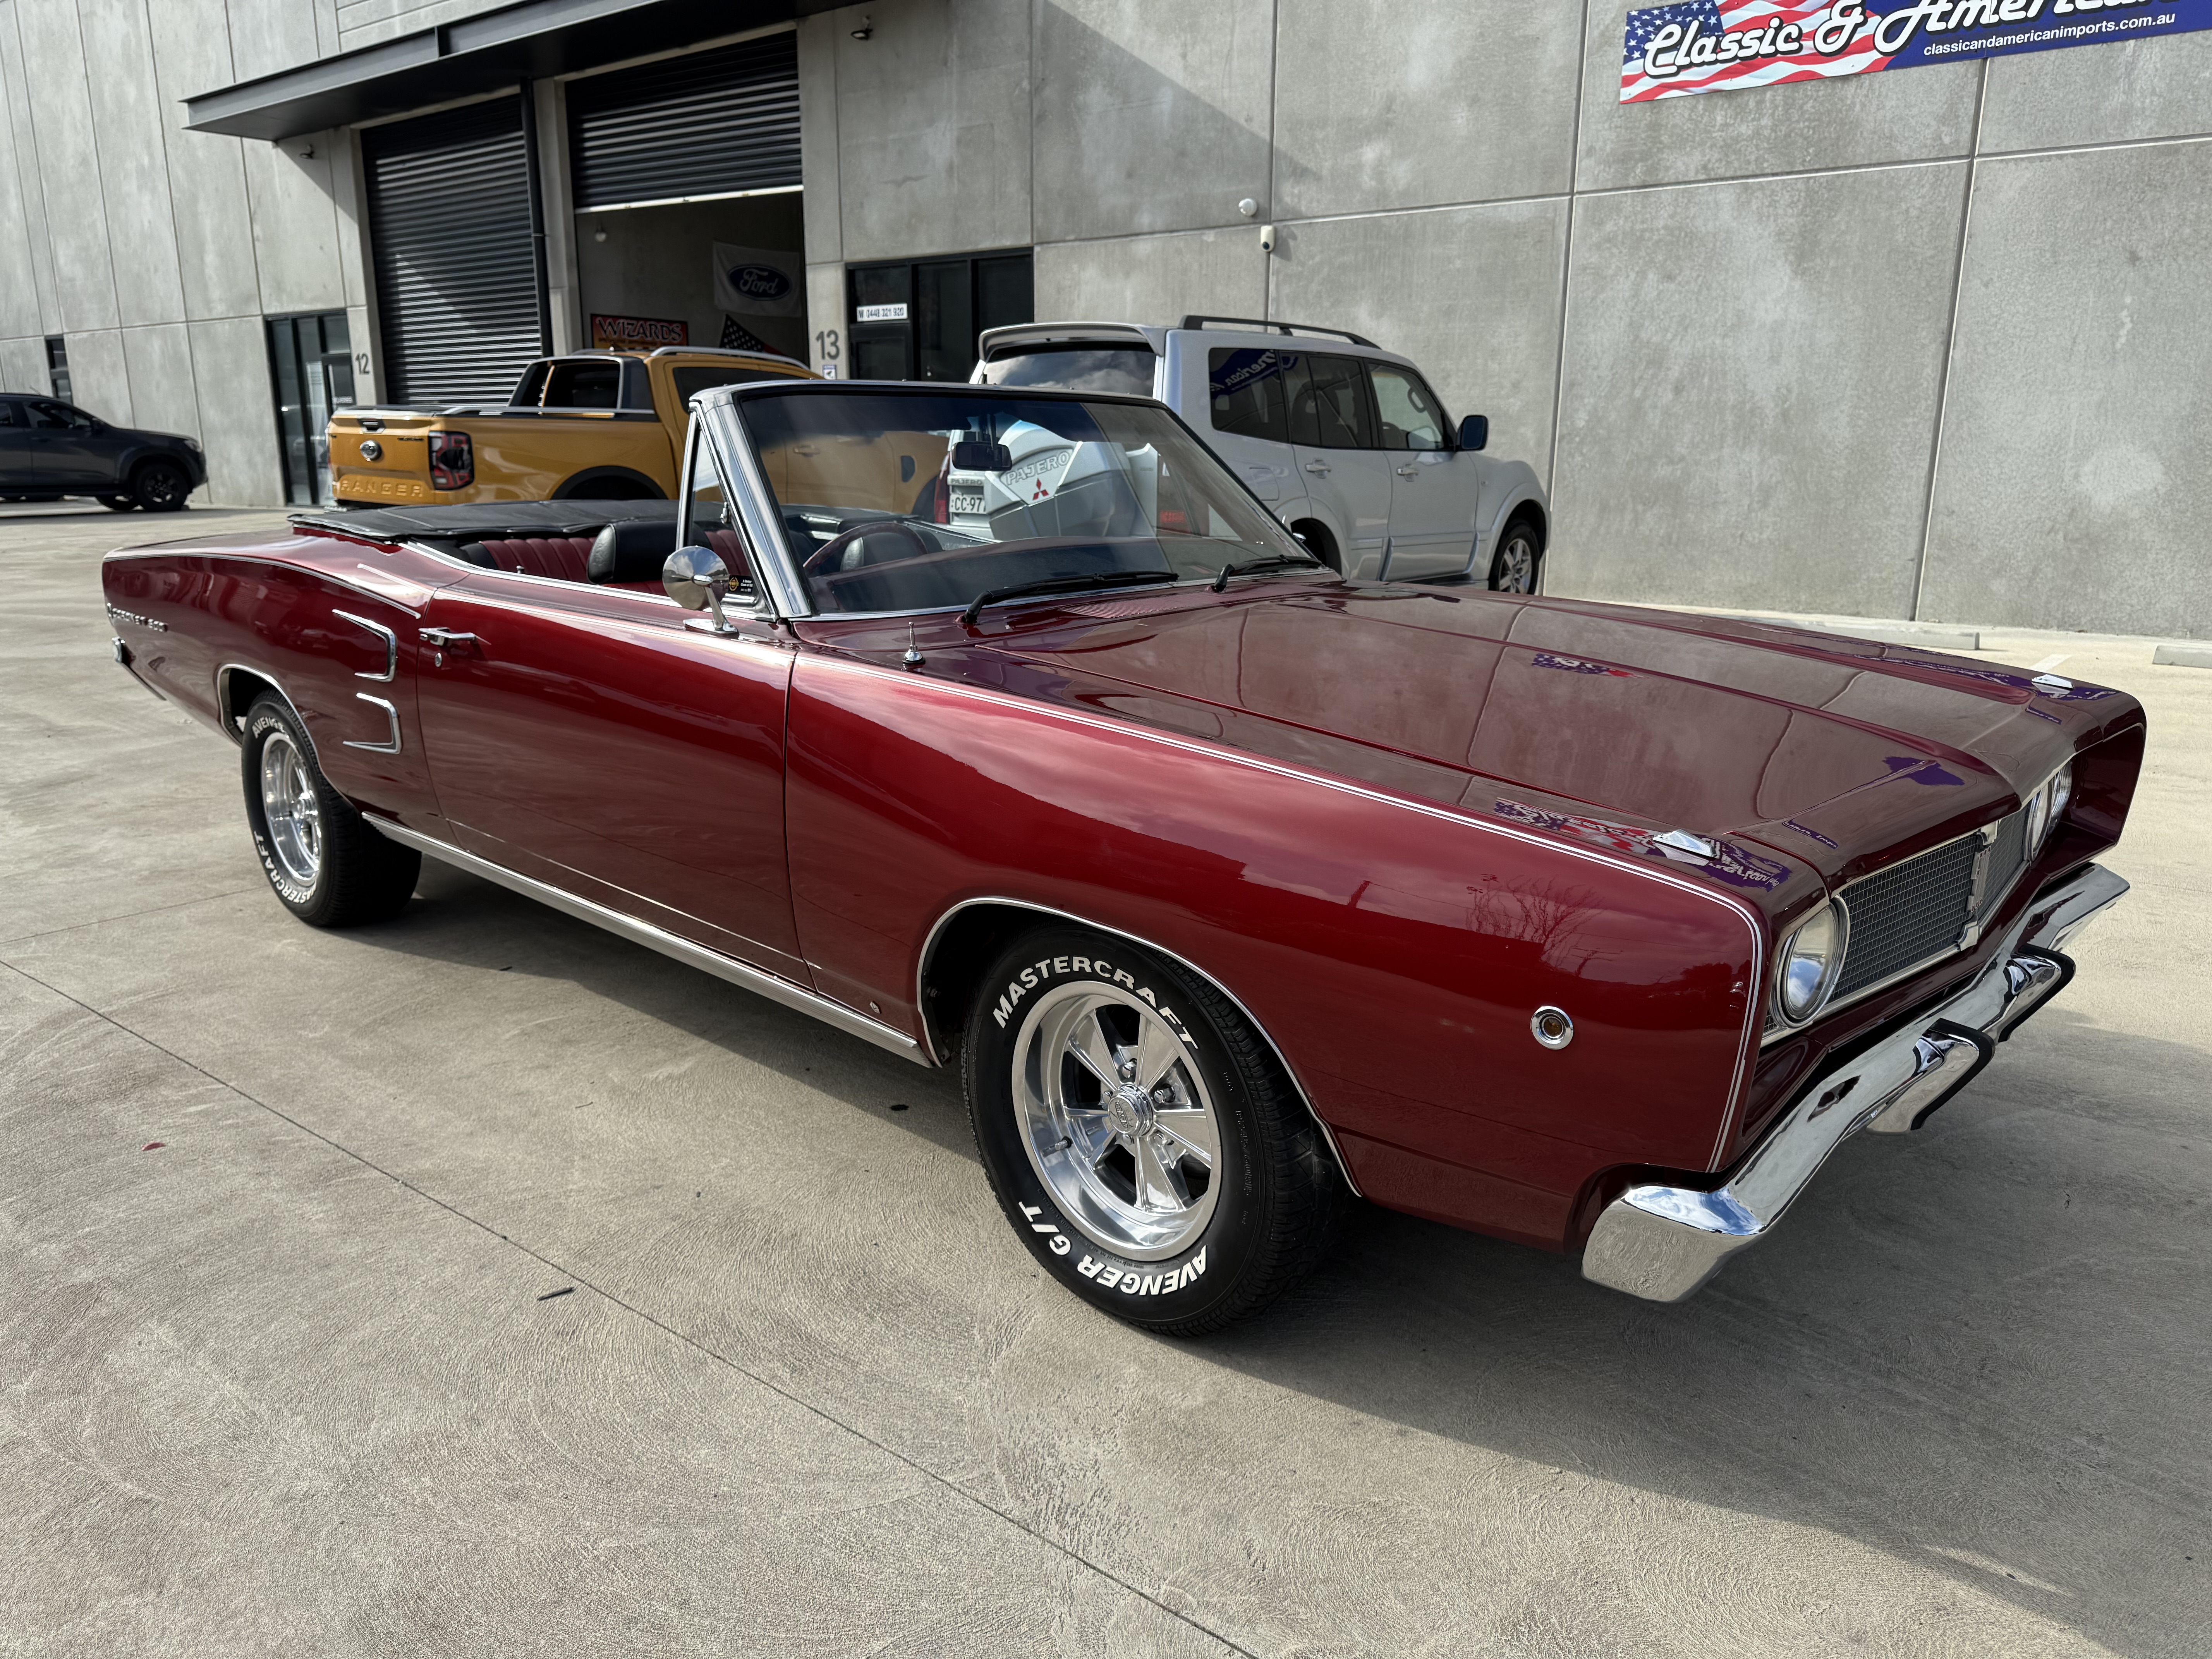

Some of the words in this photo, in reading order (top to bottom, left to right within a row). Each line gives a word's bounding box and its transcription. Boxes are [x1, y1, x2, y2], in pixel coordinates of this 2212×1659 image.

[1644, 17, 1802, 76] Classic
[1815, 0, 1865, 53] &
[1874, 0, 2146, 52] Amer
[1923, 13, 2176, 56] classicandamericanimports.com.au
[739, 268, 779, 295] Ford
[596, 318, 683, 342] WIZARDS
[816, 330, 840, 360] 13
[355, 353, 370, 375] 12
[1007, 452, 1070, 486] PAJERO
[341, 480, 423, 498] RANGER
[993, 956, 1199, 1049] MASTERCRAFT
[1018, 1201, 1072, 1255] G/T
[1077, 1245, 1207, 1295] AVENGER
